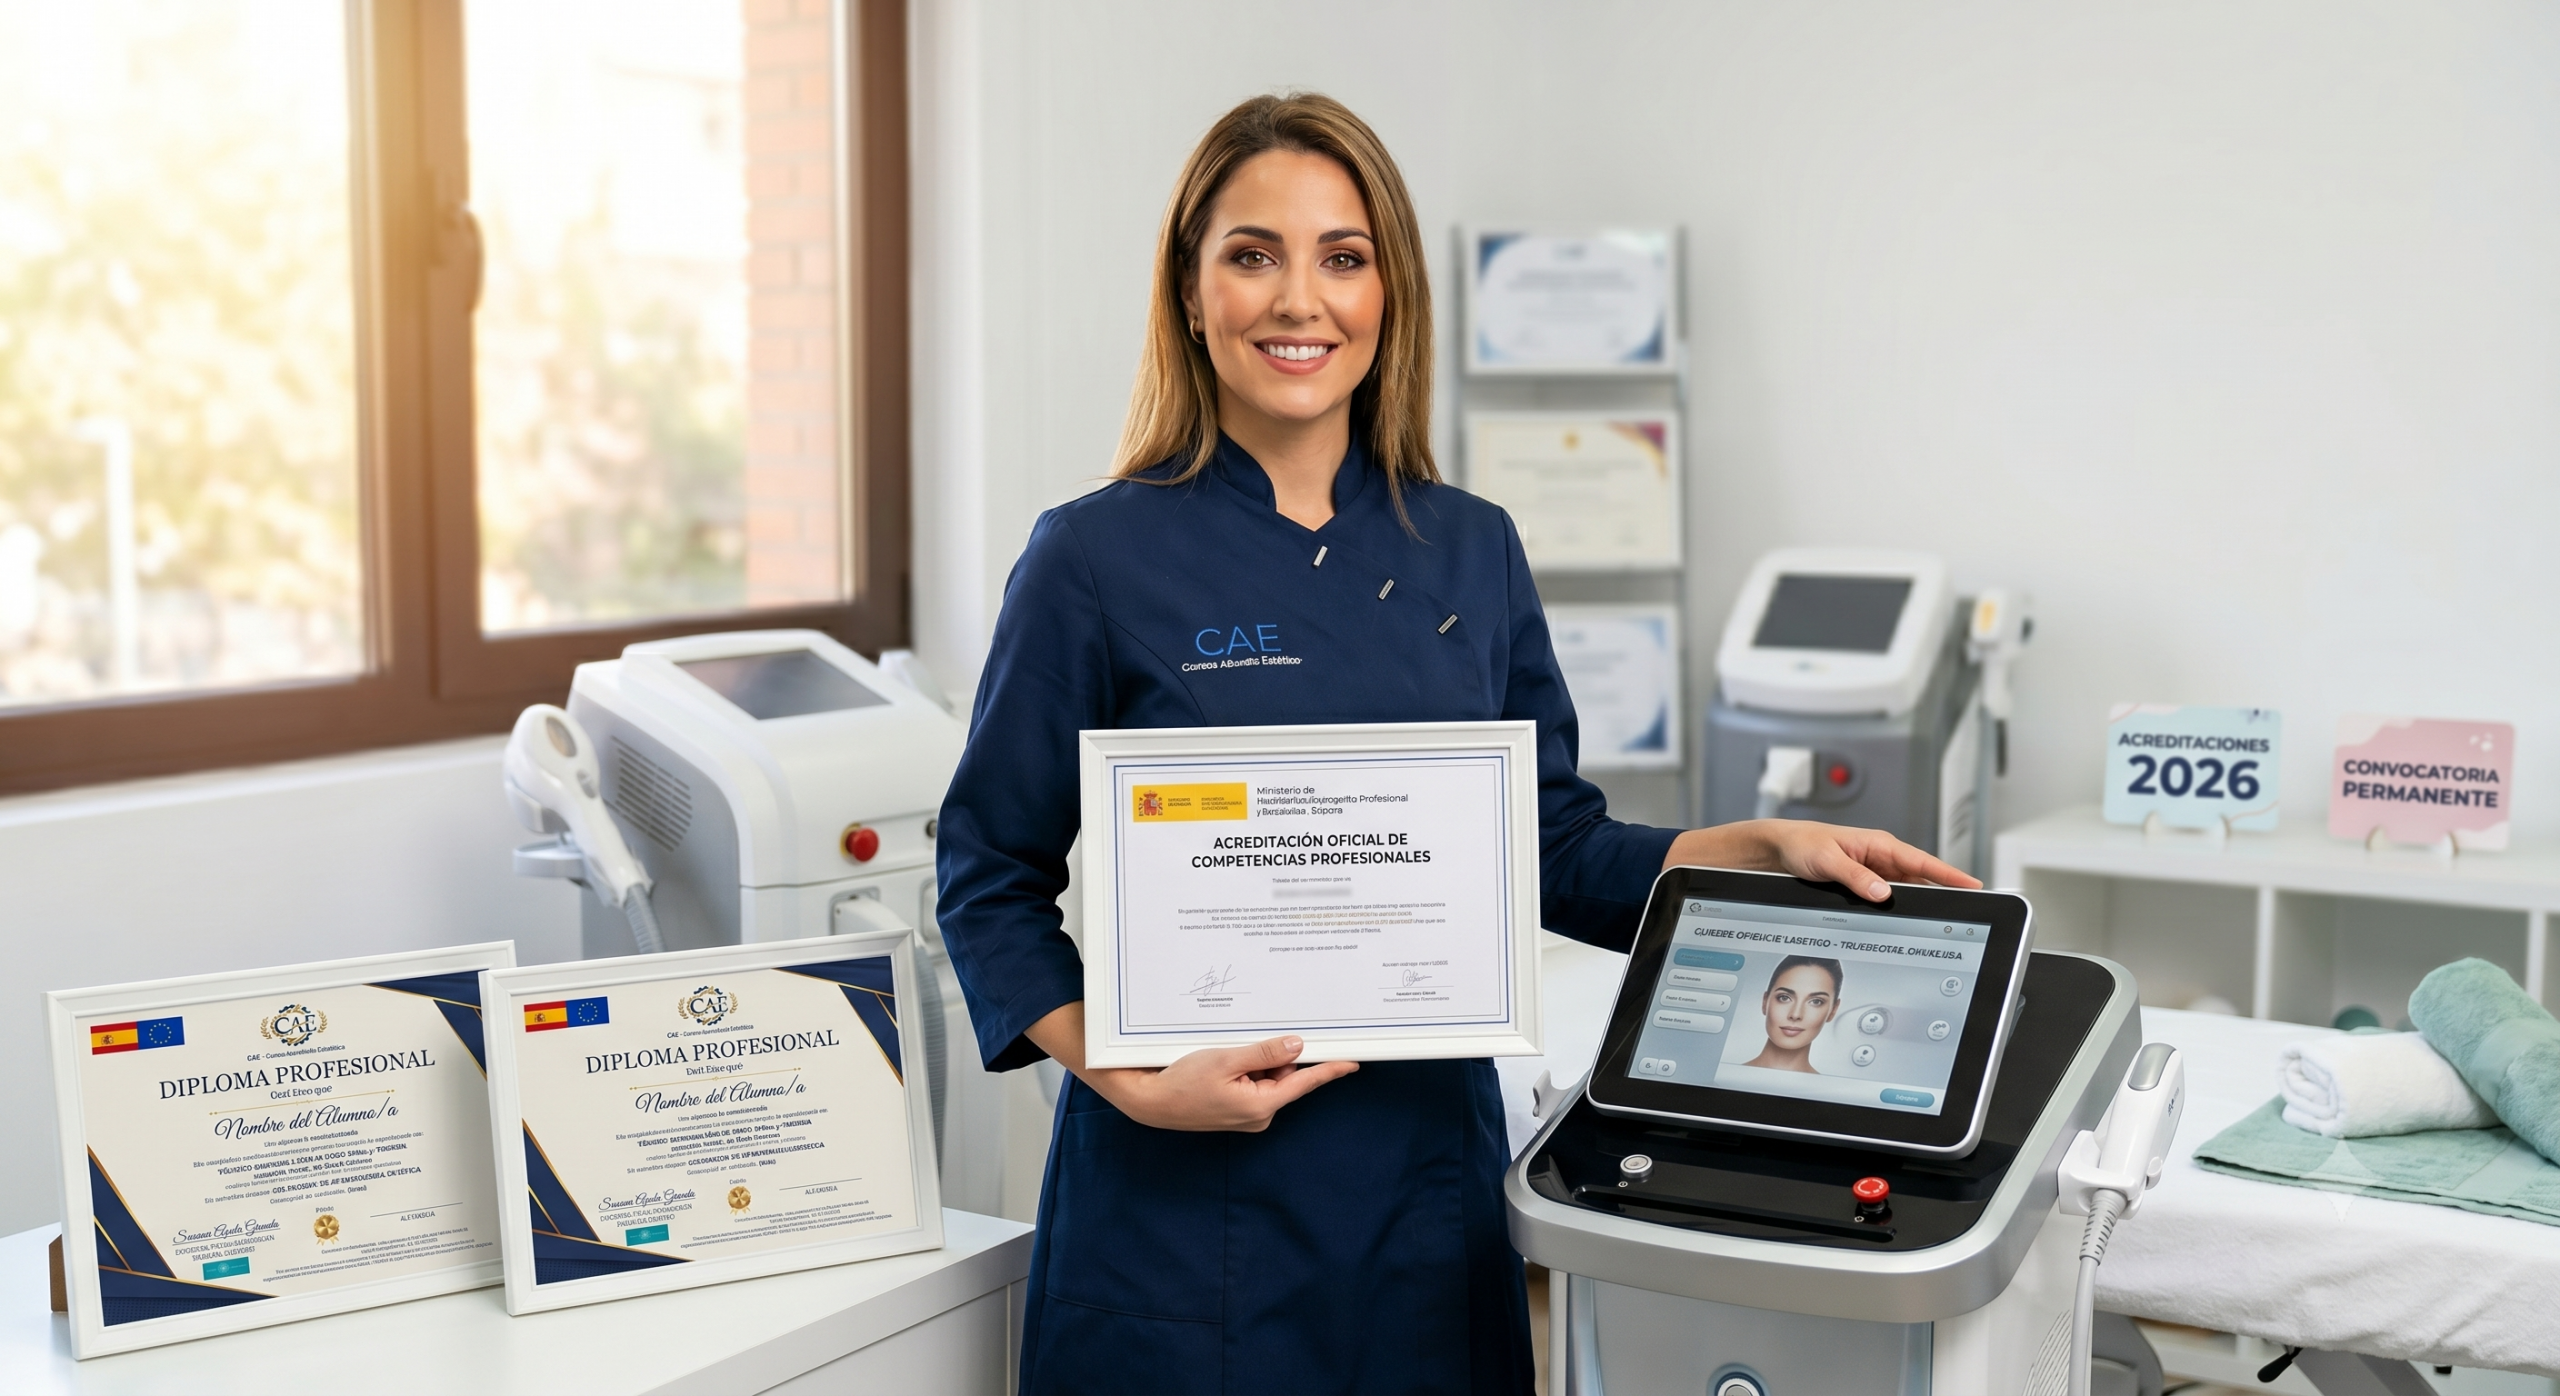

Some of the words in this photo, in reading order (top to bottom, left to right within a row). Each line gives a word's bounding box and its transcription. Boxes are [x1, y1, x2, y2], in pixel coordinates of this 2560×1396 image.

[1195, 624, 1282, 656] CAE
[2118, 732, 2270, 753] ACREDITACIONES
[2127, 754, 2260, 801] 2026
[2343, 759, 2500, 784] CONVOCATORIA
[1256, 785, 1301, 795] Ministerio
[1302, 785, 1315, 795] de
[1359, 793, 1409, 804] Profesional
[2342, 780, 2499, 809] PERMANENTE
[1213, 831, 1323, 850] ACREDITACIÓN
[1327, 832, 1385, 847] OFICIAL
[1388, 833, 1408, 846] DE
[1191, 853, 1307, 868] COMPETENCIAS
[1310, 850, 1431, 866] PROFESIONALES
[690, 995, 729, 1014] CAE
[275, 1014, 317, 1035] CAE
[666, 1031, 679, 1039] CAE
[246, 1053, 261, 1062] CAE
[585, 1046, 689, 1074] DIPLOMA
[692, 1029, 840, 1062] PROFESIONAL
[158, 1069, 271, 1100] DIPLOMA
[275, 1049, 436, 1085] PROFESIONAL
[705, 1086, 727, 1105] del
[214, 1116, 285, 1140] Nombre
[289, 1110, 313, 1130] del
